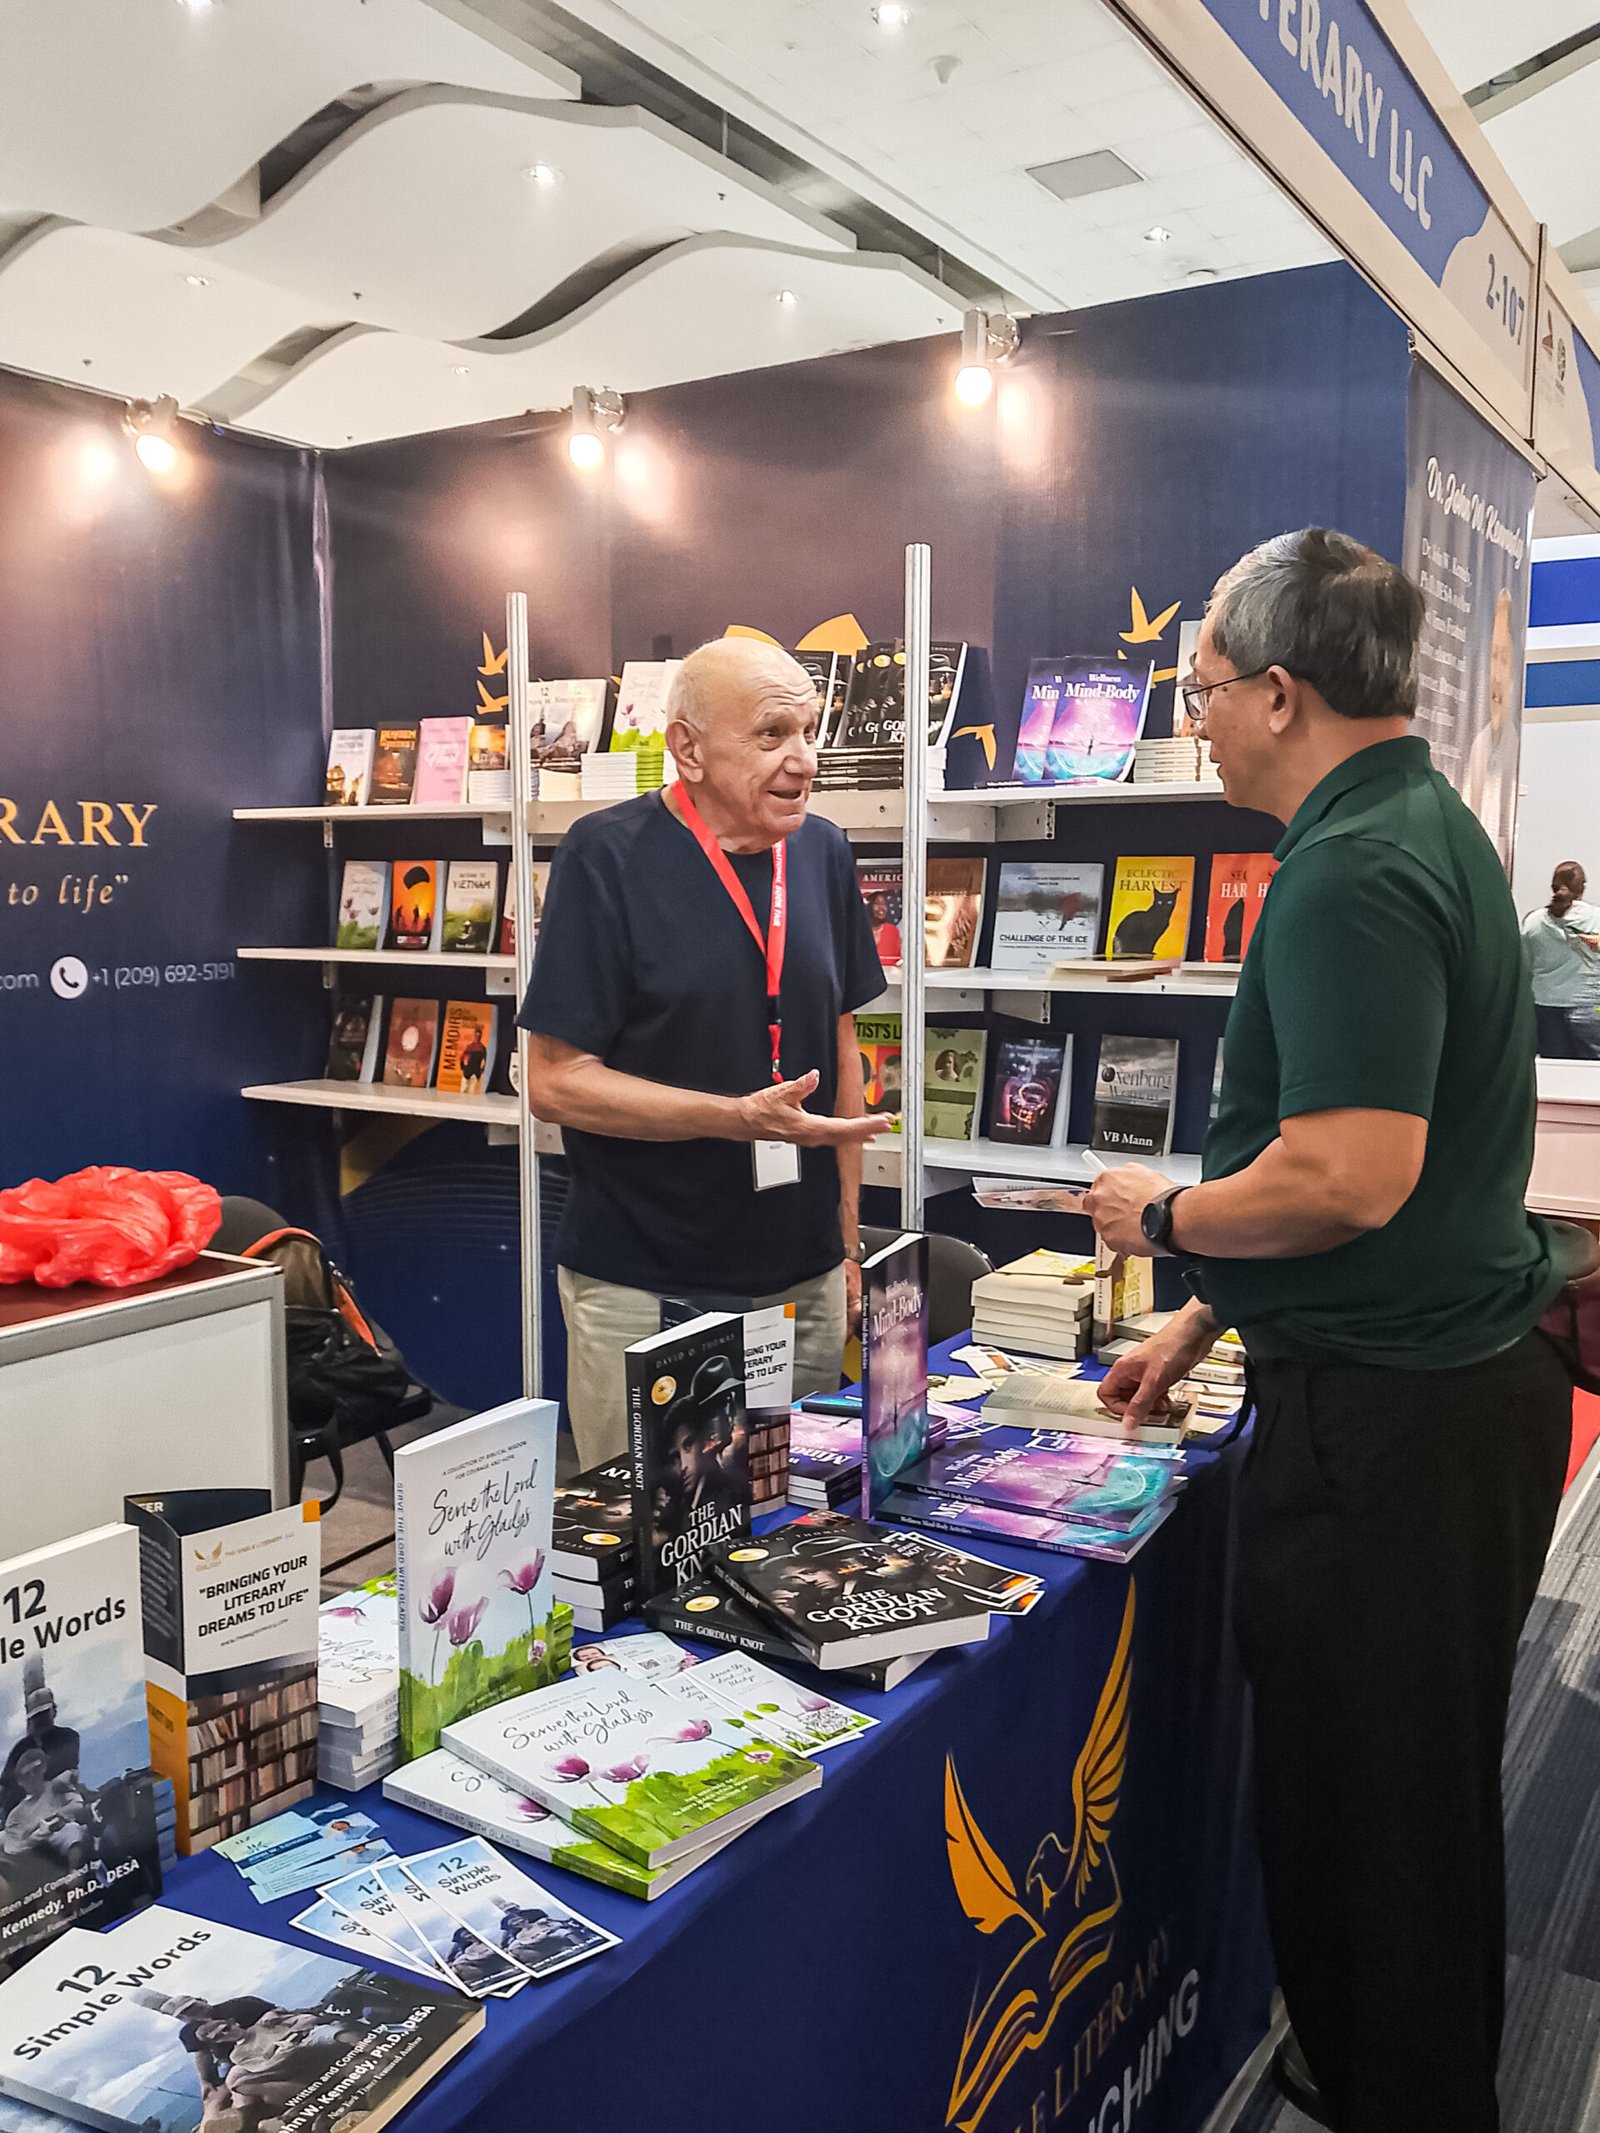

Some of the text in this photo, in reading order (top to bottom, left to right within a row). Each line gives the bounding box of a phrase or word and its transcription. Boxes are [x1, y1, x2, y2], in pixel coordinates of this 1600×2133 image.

[1389, 108, 1433, 230] LLC
[1485, 254, 1524, 346] 2-107
[1443, 473, 1471, 522] John
[1485, 504, 1524, 570] Kennedy
[1064, 682, 1141, 703] Mind-Body
[1088, 673, 1122, 683] Wellness
[0, 797, 158, 847] RARY
[453, 880, 491, 890] VIETNAM
[1119, 880, 1188, 892] HARVEST
[1126, 868, 1180, 879] ECLECTIC
[7, 882, 39, 906] to
[999, 934, 1089, 943] CHALLENGE OF THE ICE
[114, 965, 160, 990] (209)
[164, 961, 235, 984] 692-5191
[443, 1007, 463, 1071] MEMOIRS
[1103, 1130, 1153, 1147] VB Mann
[873, 1286, 924, 1341] Mind-Body
[765, 1340, 787, 1352] YOUR
[756, 1367, 767, 1378] TO
[631, 1386, 645, 1491] THE GORDIAN KNOT
[945, 1447, 1029, 1489] Mind-Body
[429, 1458, 538, 1535] Serve the Lord
[688, 1501, 717, 1528] THE
[444, 1499, 531, 1561] with Gladys
[660, 1502, 744, 1568] GORDIAN
[272, 1555, 308, 1577] YOUR
[3, 1577, 48, 1625] 12
[224, 1579, 287, 1611] LITERARY
[806, 1586, 948, 1626] GORDIAN
[842, 1587, 892, 1603] THE
[33, 1594, 127, 1651] Words
[198, 1608, 256, 1637] DREAMS
[259, 1600, 275, 1616] TO
[840, 1602, 938, 1631] KNOT
[674, 1618, 766, 1653] THE GORDIAN KNOT
[503, 1719, 568, 1750] Serve
[565, 1708, 594, 1725] the
[587, 1689, 632, 1716] Lord
[543, 1707, 654, 1752] with Gladys
[23, 1887, 43, 1904] and
[43, 1863, 89, 1893] Compiled
[106, 1858, 140, 1883] DESA
[437, 1856, 469, 1875] 12
[437, 1862, 492, 1890] Simple
[448, 1871, 503, 1897] Words
[12, 1928, 212, 2063] Simple Words
[56, 1961, 118, 1995] 12
[285, 2023, 388, 2108] Written and Compiled by
[299, 2103, 324, 2118] W.
[400, 2004, 437, 2030] DESA
[327, 2105, 344, 2120] New
[399, 2035, 424, 2057] Author
